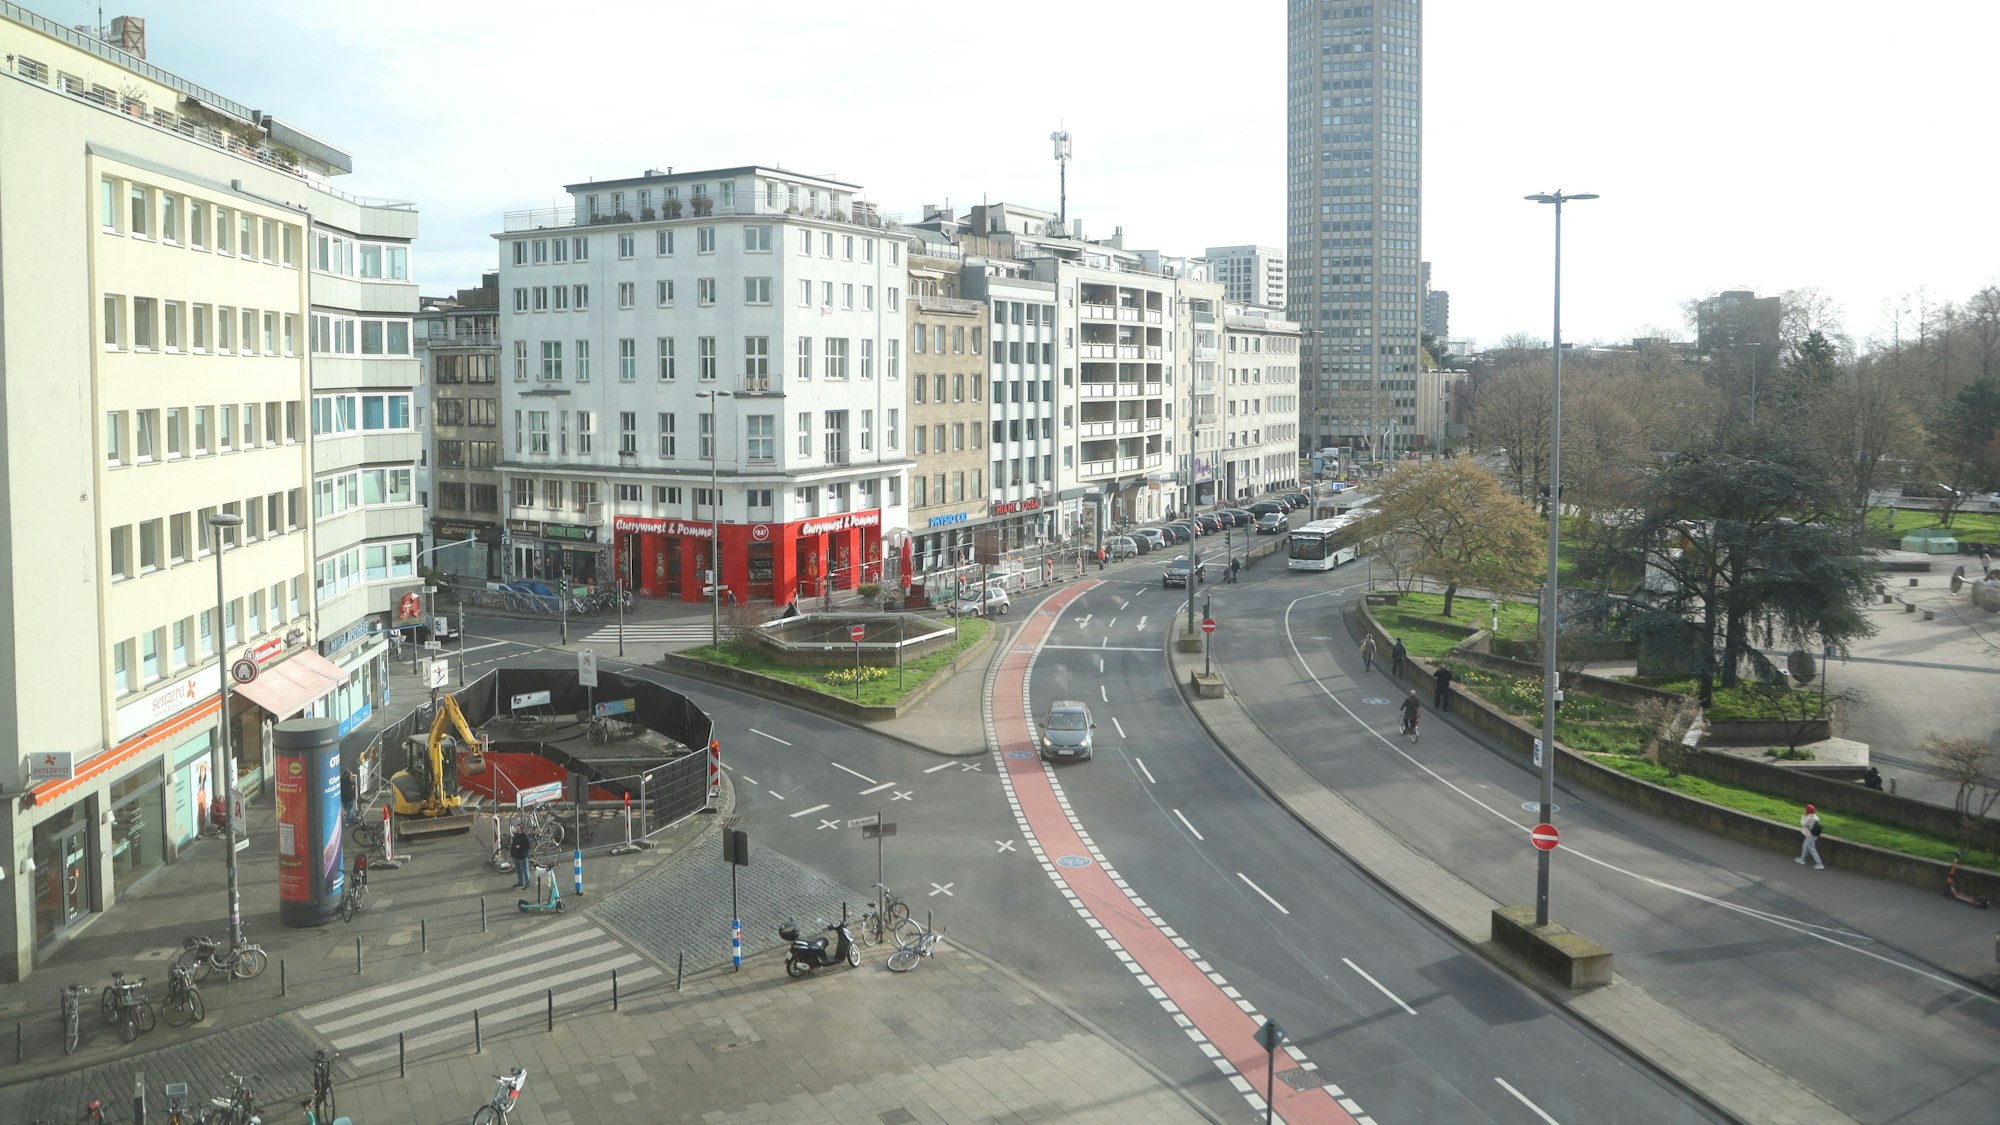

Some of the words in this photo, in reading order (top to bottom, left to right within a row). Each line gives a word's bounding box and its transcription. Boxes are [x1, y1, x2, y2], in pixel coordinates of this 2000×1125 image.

[996, 503, 1015, 514] MIAMI
[616, 519, 667, 534] Currywurst
[668, 522, 675, 533] &
[803, 517, 843, 535] Currywurst
[844, 516, 850, 528] &
[850, 514, 879, 528] Pommes
[153, 686, 184, 711] senzera
